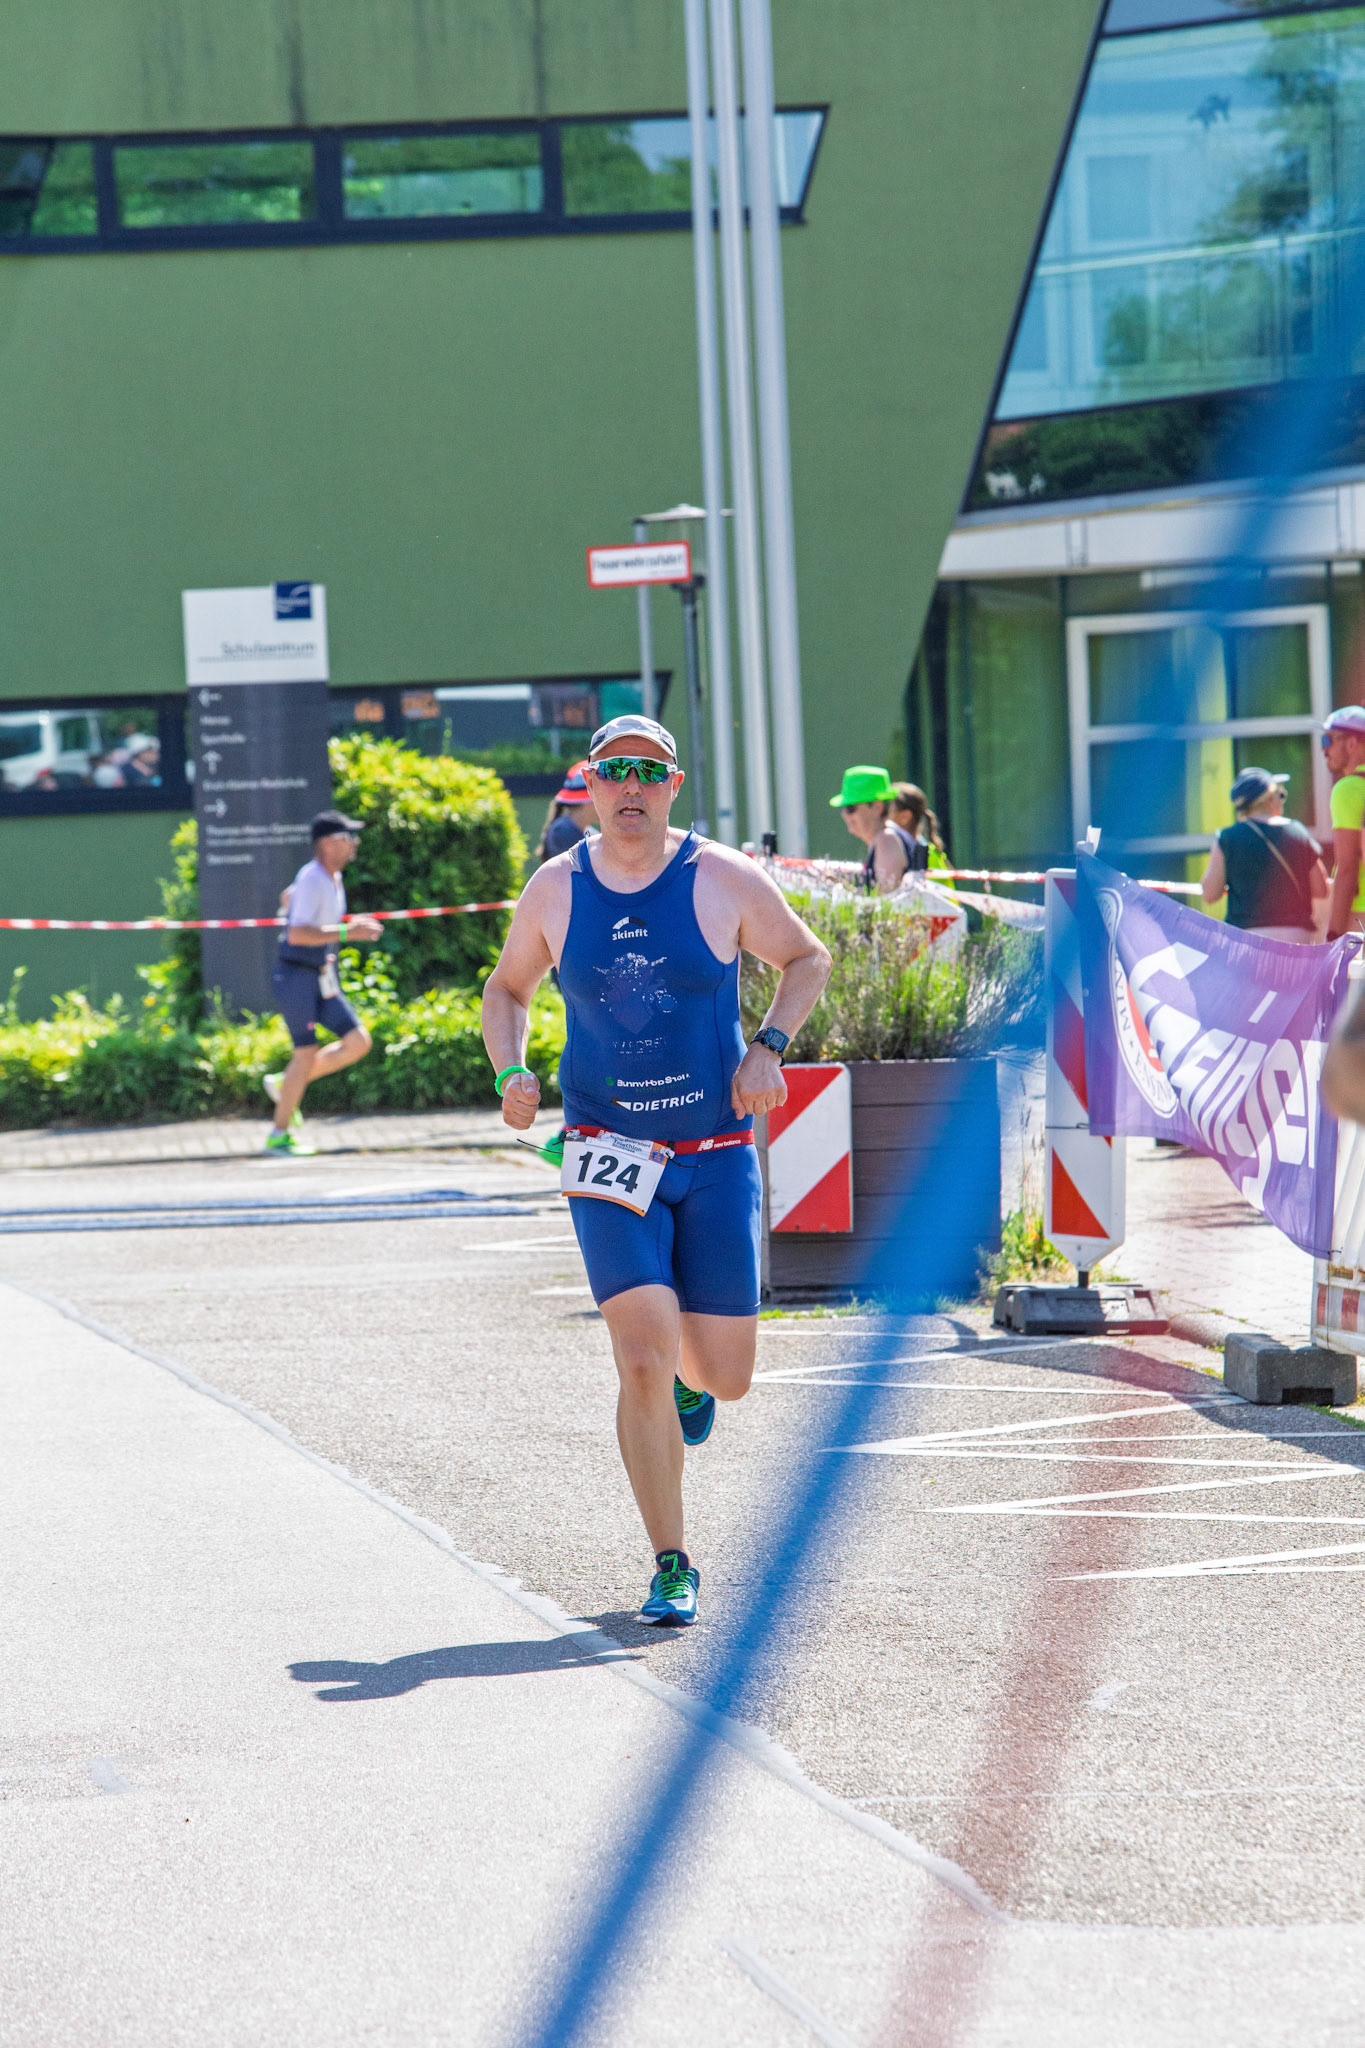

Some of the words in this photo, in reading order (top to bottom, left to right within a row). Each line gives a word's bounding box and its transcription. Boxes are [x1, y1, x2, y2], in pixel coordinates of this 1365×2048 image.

[612, 928, 648, 941] skinfit
[632, 1088, 704, 1111] DIETRICH
[614, 1139, 642, 1152] Triathlon
[577, 1151, 641, 1194] 124
